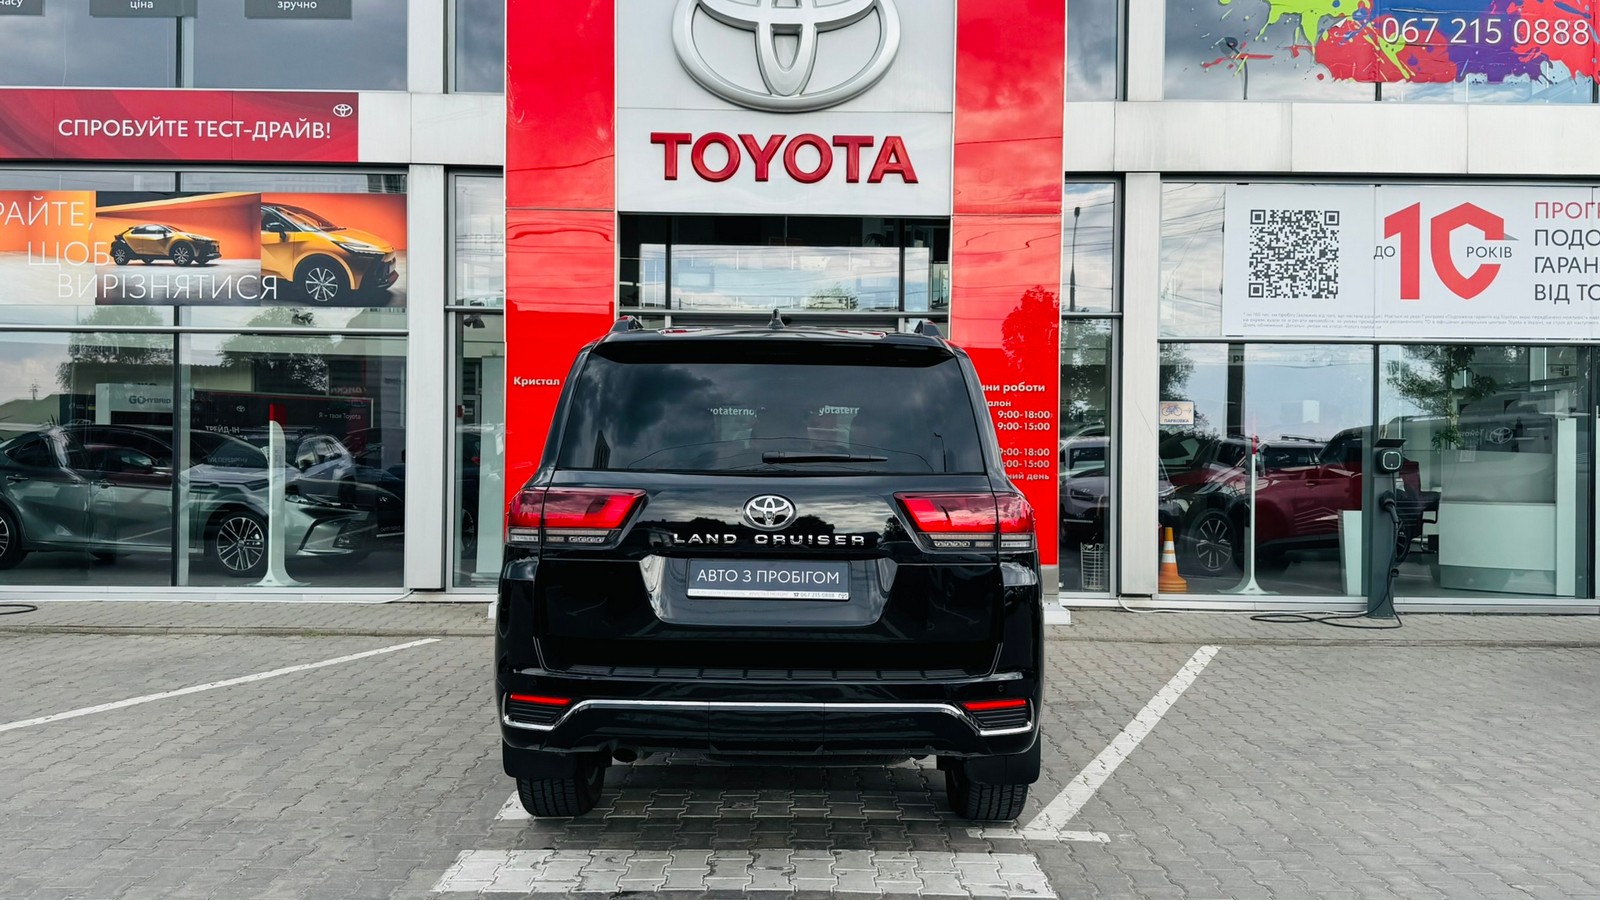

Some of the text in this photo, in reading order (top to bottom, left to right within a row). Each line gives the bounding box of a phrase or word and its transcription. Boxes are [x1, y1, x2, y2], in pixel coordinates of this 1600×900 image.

[130, 0, 154, 10] ціна
[277, 0, 317, 12] зручно
[1381, 17, 1591, 46] 067 215 0888
[58, 116, 331, 141] СПРОБУЙТЕ ТЕСТ-ДРАЙВ!
[650, 131, 919, 184] TOYOTA
[27, 240, 110, 270] ЩОБ
[1374, 245, 1396, 260] ДО
[1466, 245, 1513, 259] РОКІВ
[1535, 256, 1599, 274] ГАРАН
[57, 273, 278, 301] ВИРІЗНЯТИСЯ
[1535, 283, 1600, 305] ВІД ТО
[513, 375, 560, 388] Кристал
[1003, 381, 1045, 394] роботи
[343, 412, 361, 421] Toyota
[997, 410, 1050, 419] 9:00-18:00
[997, 422, 1050, 431] 9:00-15:00
[1026, 473, 1050, 481] день
[673, 532, 866, 547] LAND CRUISER
[696, 569, 840, 585] АВТО З ПРОБІГОМ
